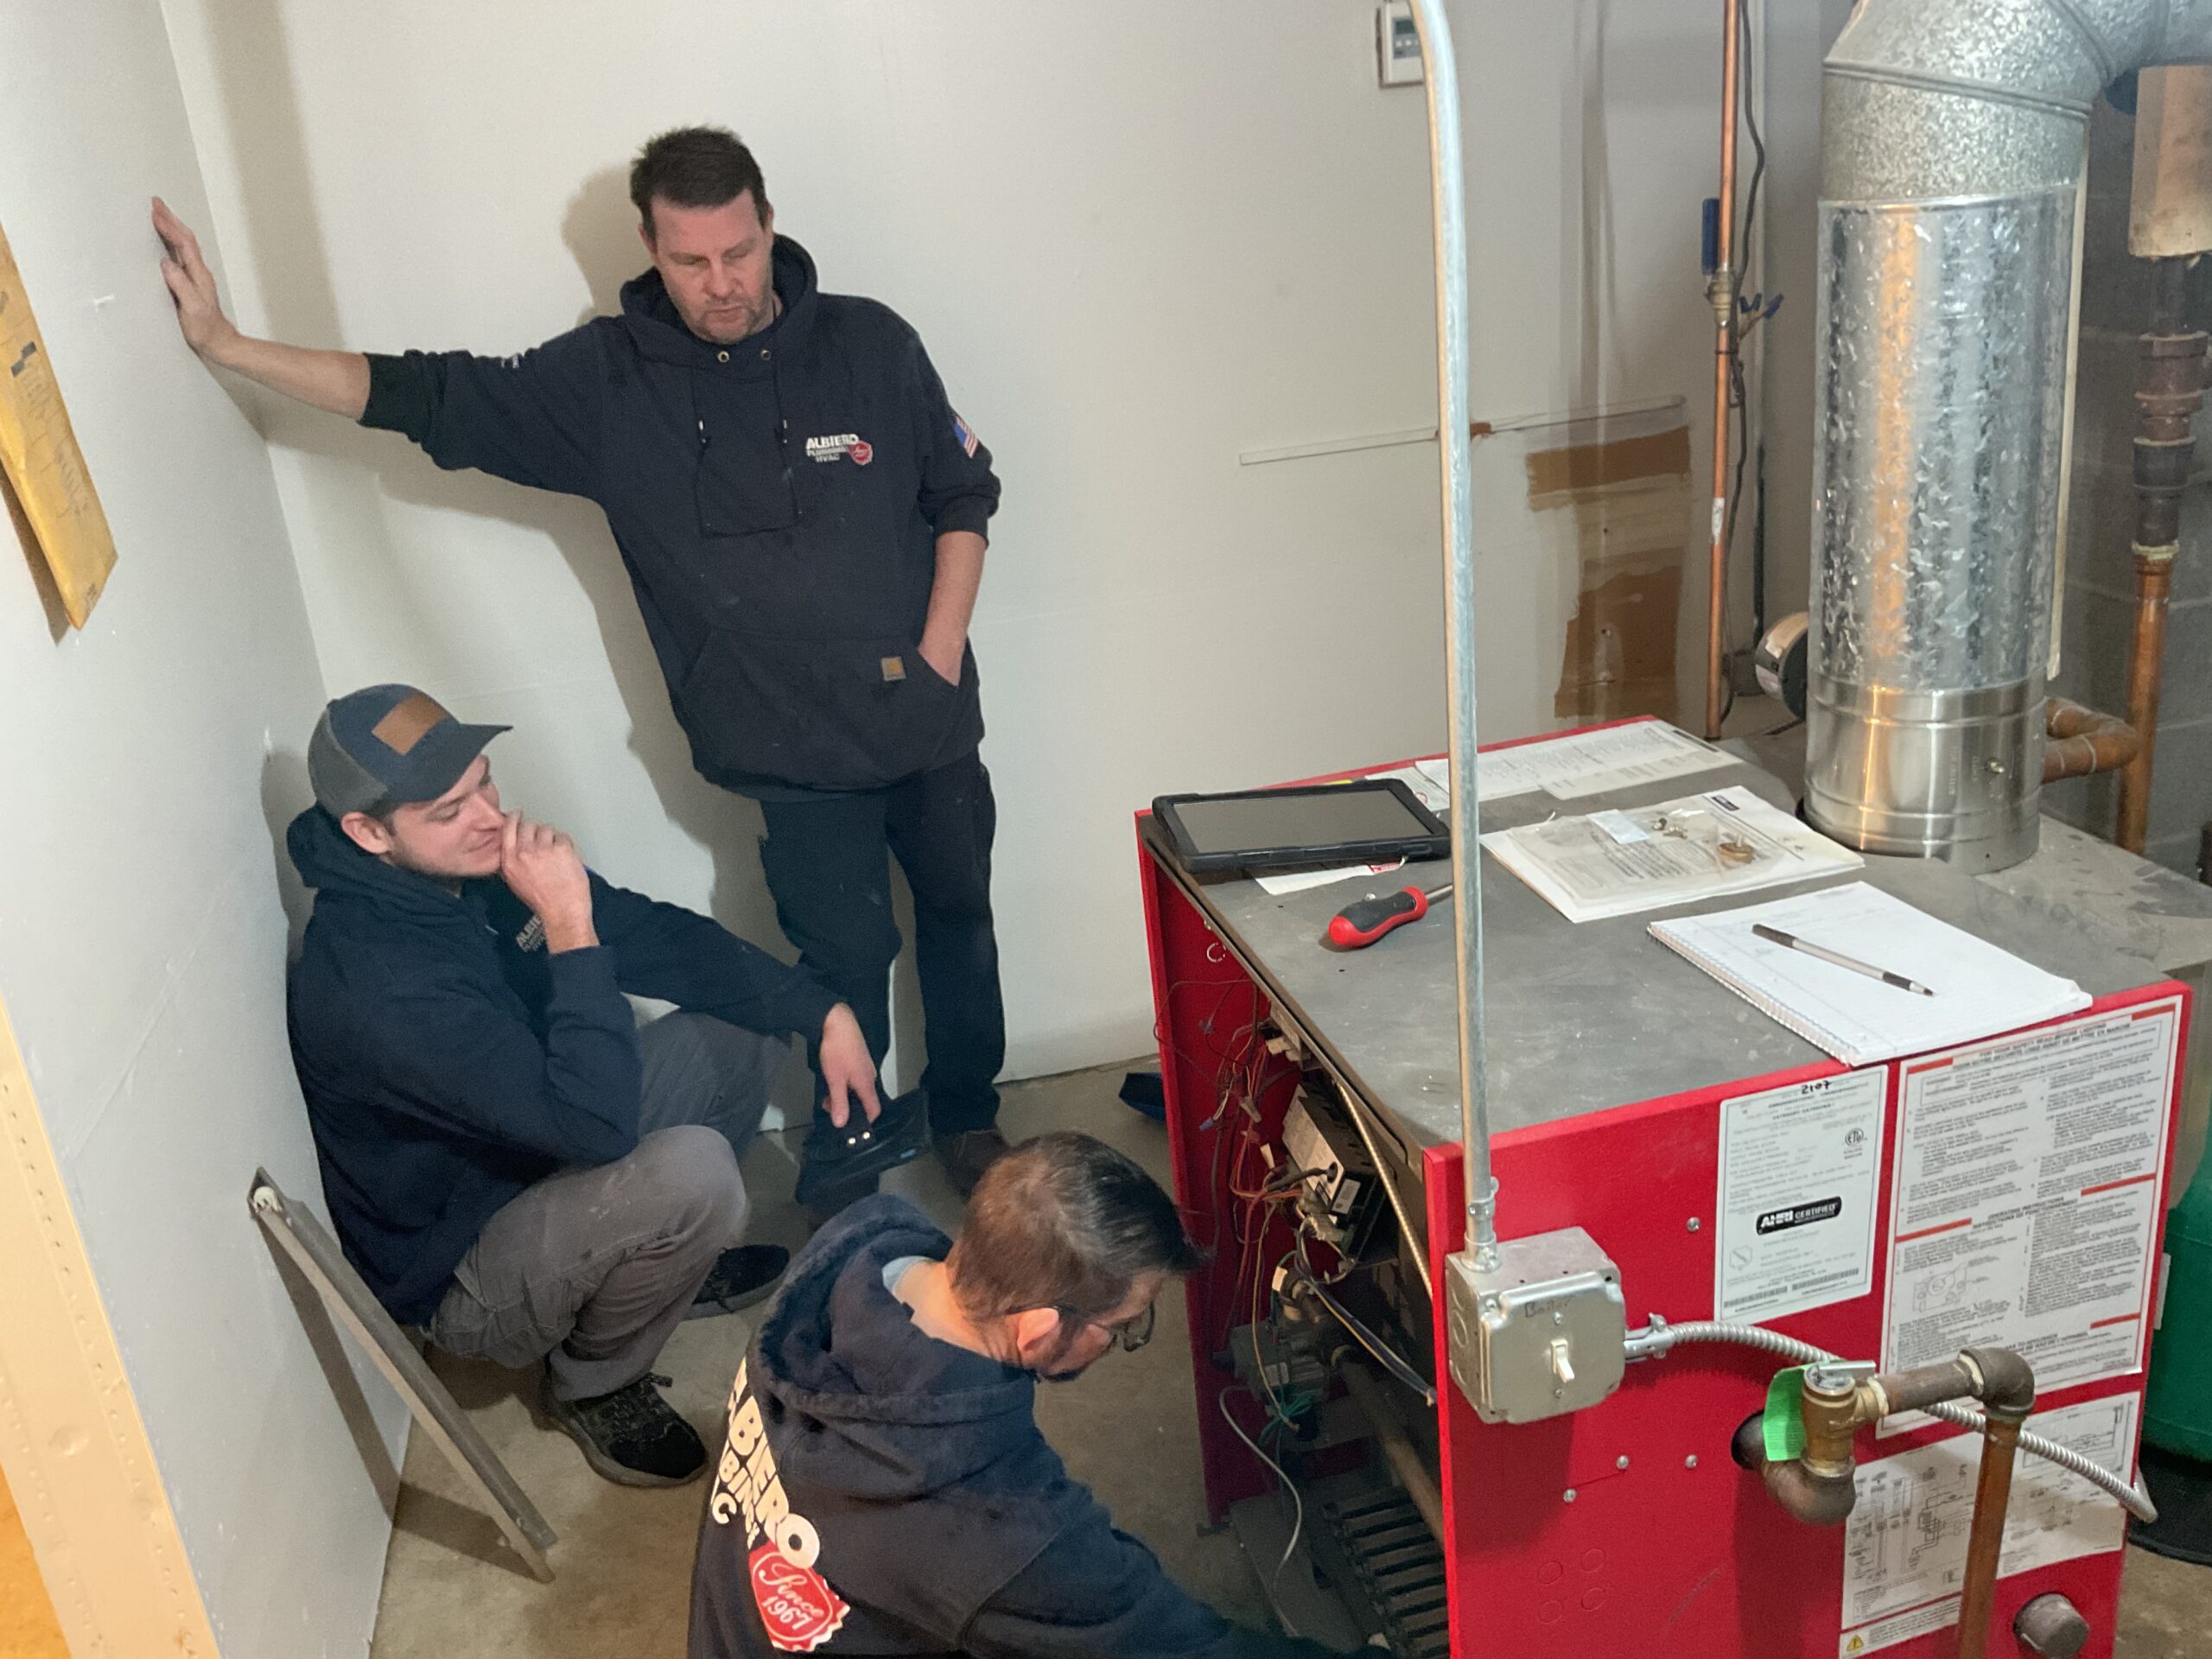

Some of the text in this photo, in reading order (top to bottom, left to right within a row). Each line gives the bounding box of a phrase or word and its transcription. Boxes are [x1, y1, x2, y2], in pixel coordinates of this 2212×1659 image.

[806, 434, 859, 449] ALBIERO
[759, 1562, 824, 1618] Since
[762, 1595, 814, 1630] 1967
